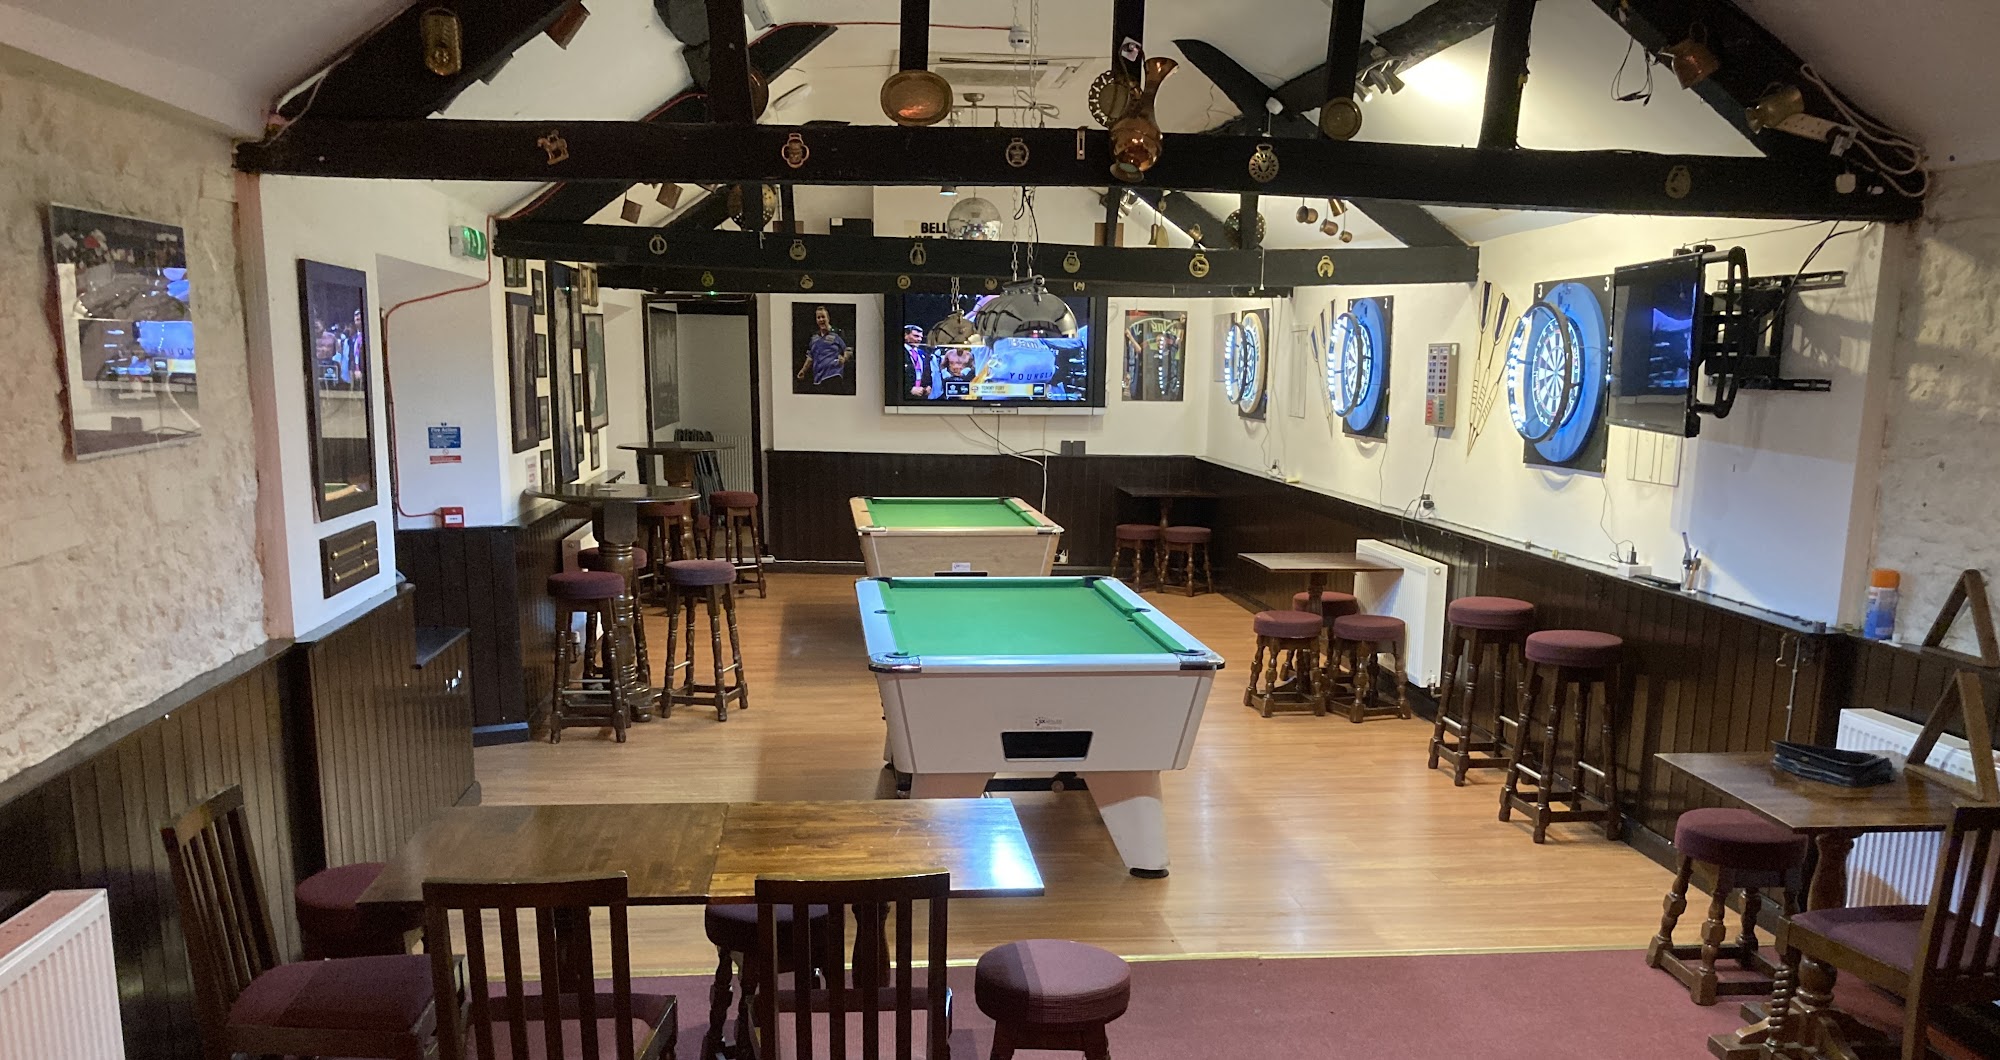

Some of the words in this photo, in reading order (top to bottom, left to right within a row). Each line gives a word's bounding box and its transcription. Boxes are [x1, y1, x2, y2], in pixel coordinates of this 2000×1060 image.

[921, 222, 948, 234] BELL
[1537, 284, 1543, 298] 3
[1604, 276, 1610, 292] 3
